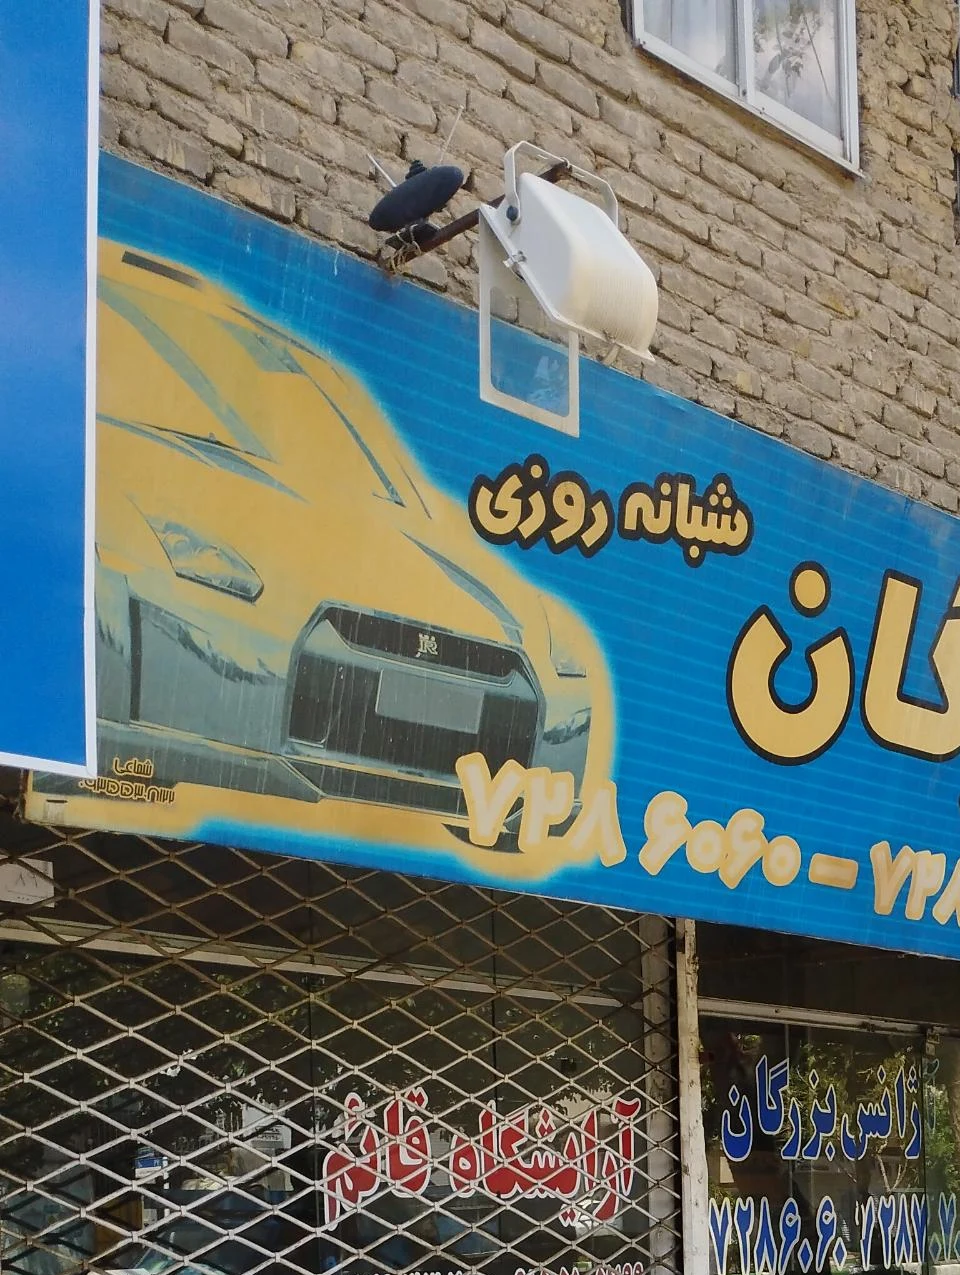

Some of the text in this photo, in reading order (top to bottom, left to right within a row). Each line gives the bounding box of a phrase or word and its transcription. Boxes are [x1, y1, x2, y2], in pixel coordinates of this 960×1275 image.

[470, 455, 753, 566] شبانه روزی
[450, 1097, 641, 1228] آرایشگاه
[721, 1054, 838, 1161] بزرگان
